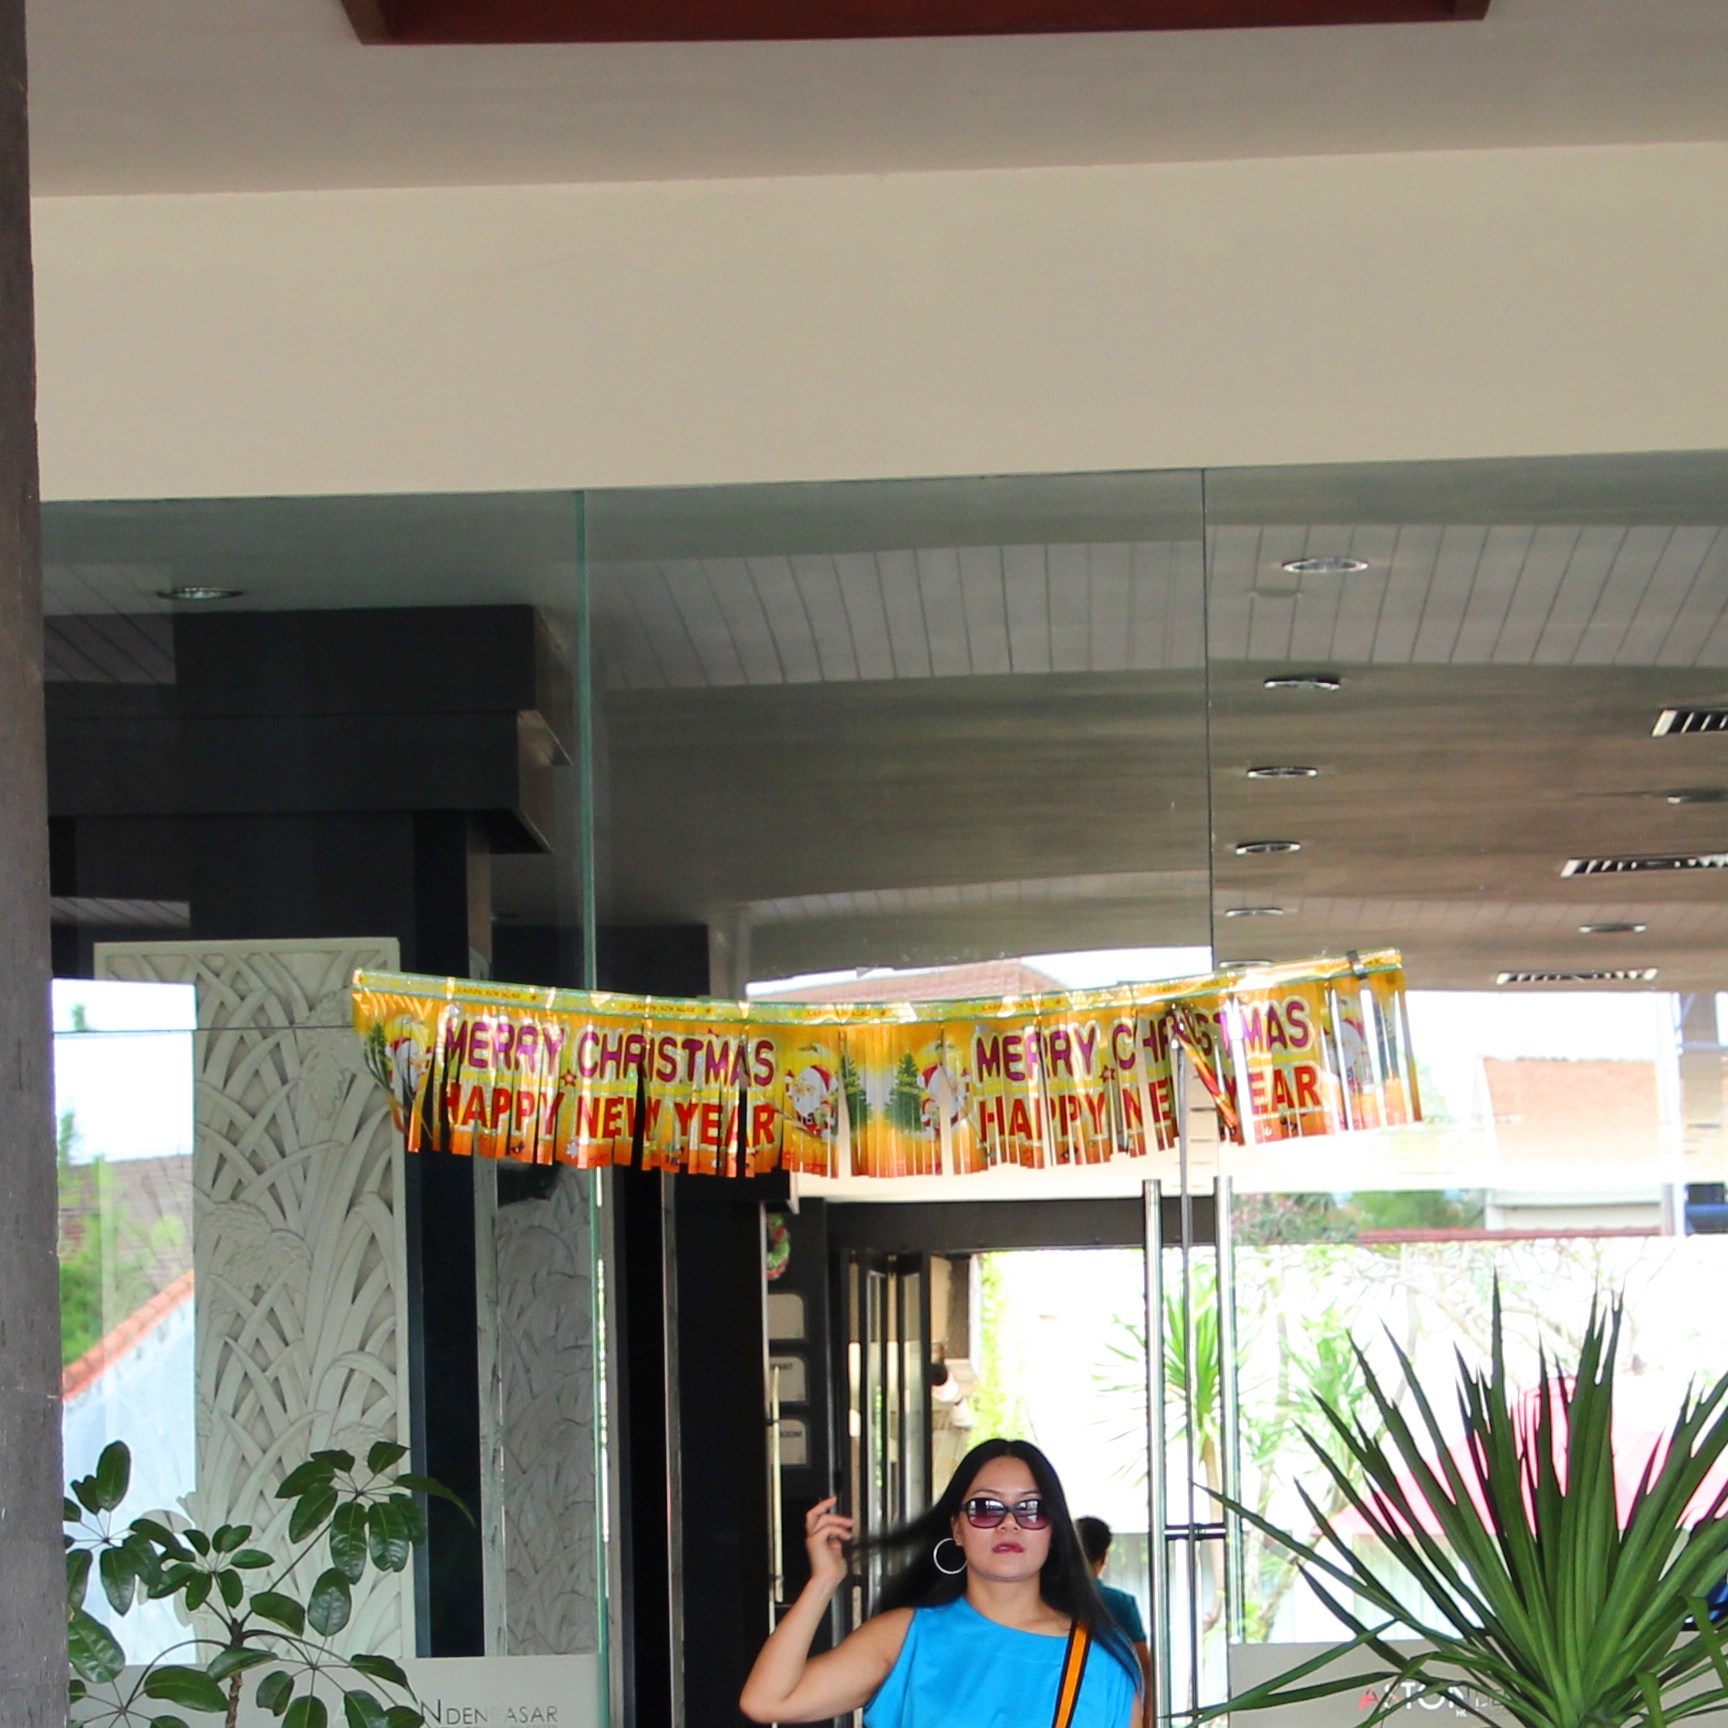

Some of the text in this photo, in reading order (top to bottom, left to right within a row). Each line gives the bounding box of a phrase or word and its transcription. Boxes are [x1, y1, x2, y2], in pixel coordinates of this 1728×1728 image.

[445, 1018, 775, 1088] MERRY CHRISTMAS
[976, 1026, 1097, 1083] MERRY
[440, 1082, 776, 1148] HAPPY NEW YEAR
[979, 1090, 1108, 1143] HAPPY
[1122, 1074, 1179, 1132] NE
[446, 1705, 558, 1725] DENPASAR
